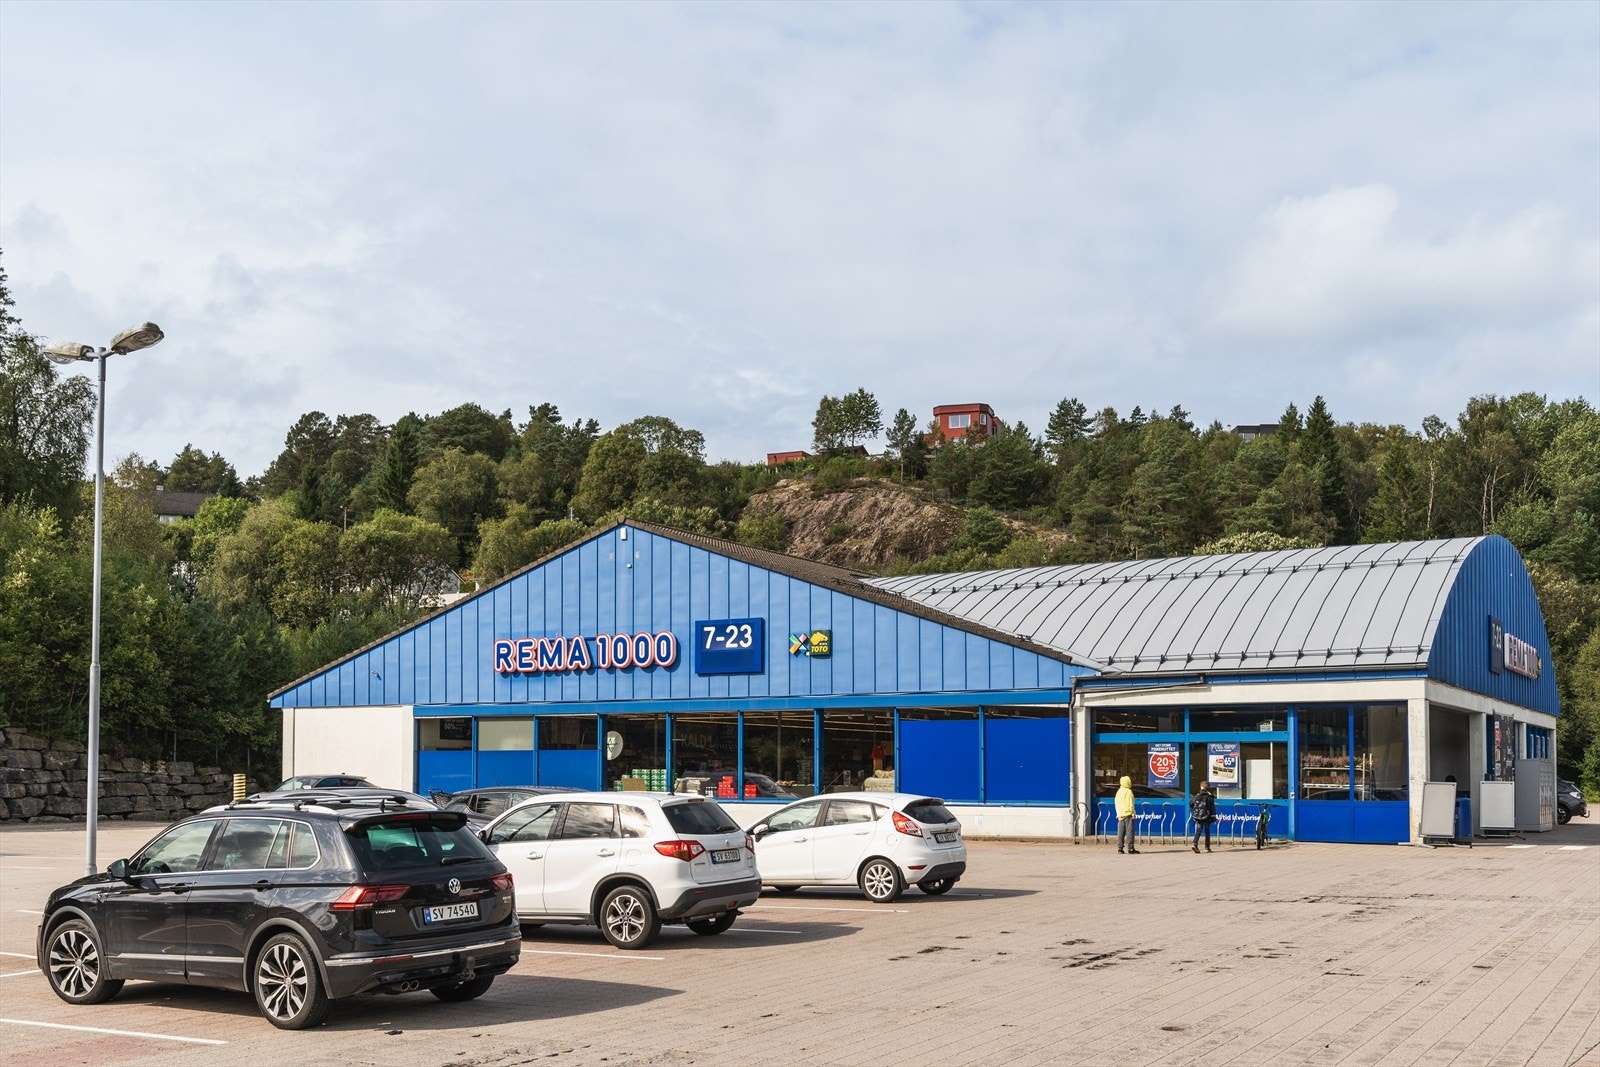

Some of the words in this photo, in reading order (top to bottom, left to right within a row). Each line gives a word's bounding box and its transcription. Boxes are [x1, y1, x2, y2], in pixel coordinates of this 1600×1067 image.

[703, 625, 753, 650] 7-23
[494, 634, 591, 673] REMA
[596, 631, 677, 669] 1000
[811, 645, 829, 653] TOTO
[433, 907, 445, 920] SV
[447, 904, 475, 918] 74540
